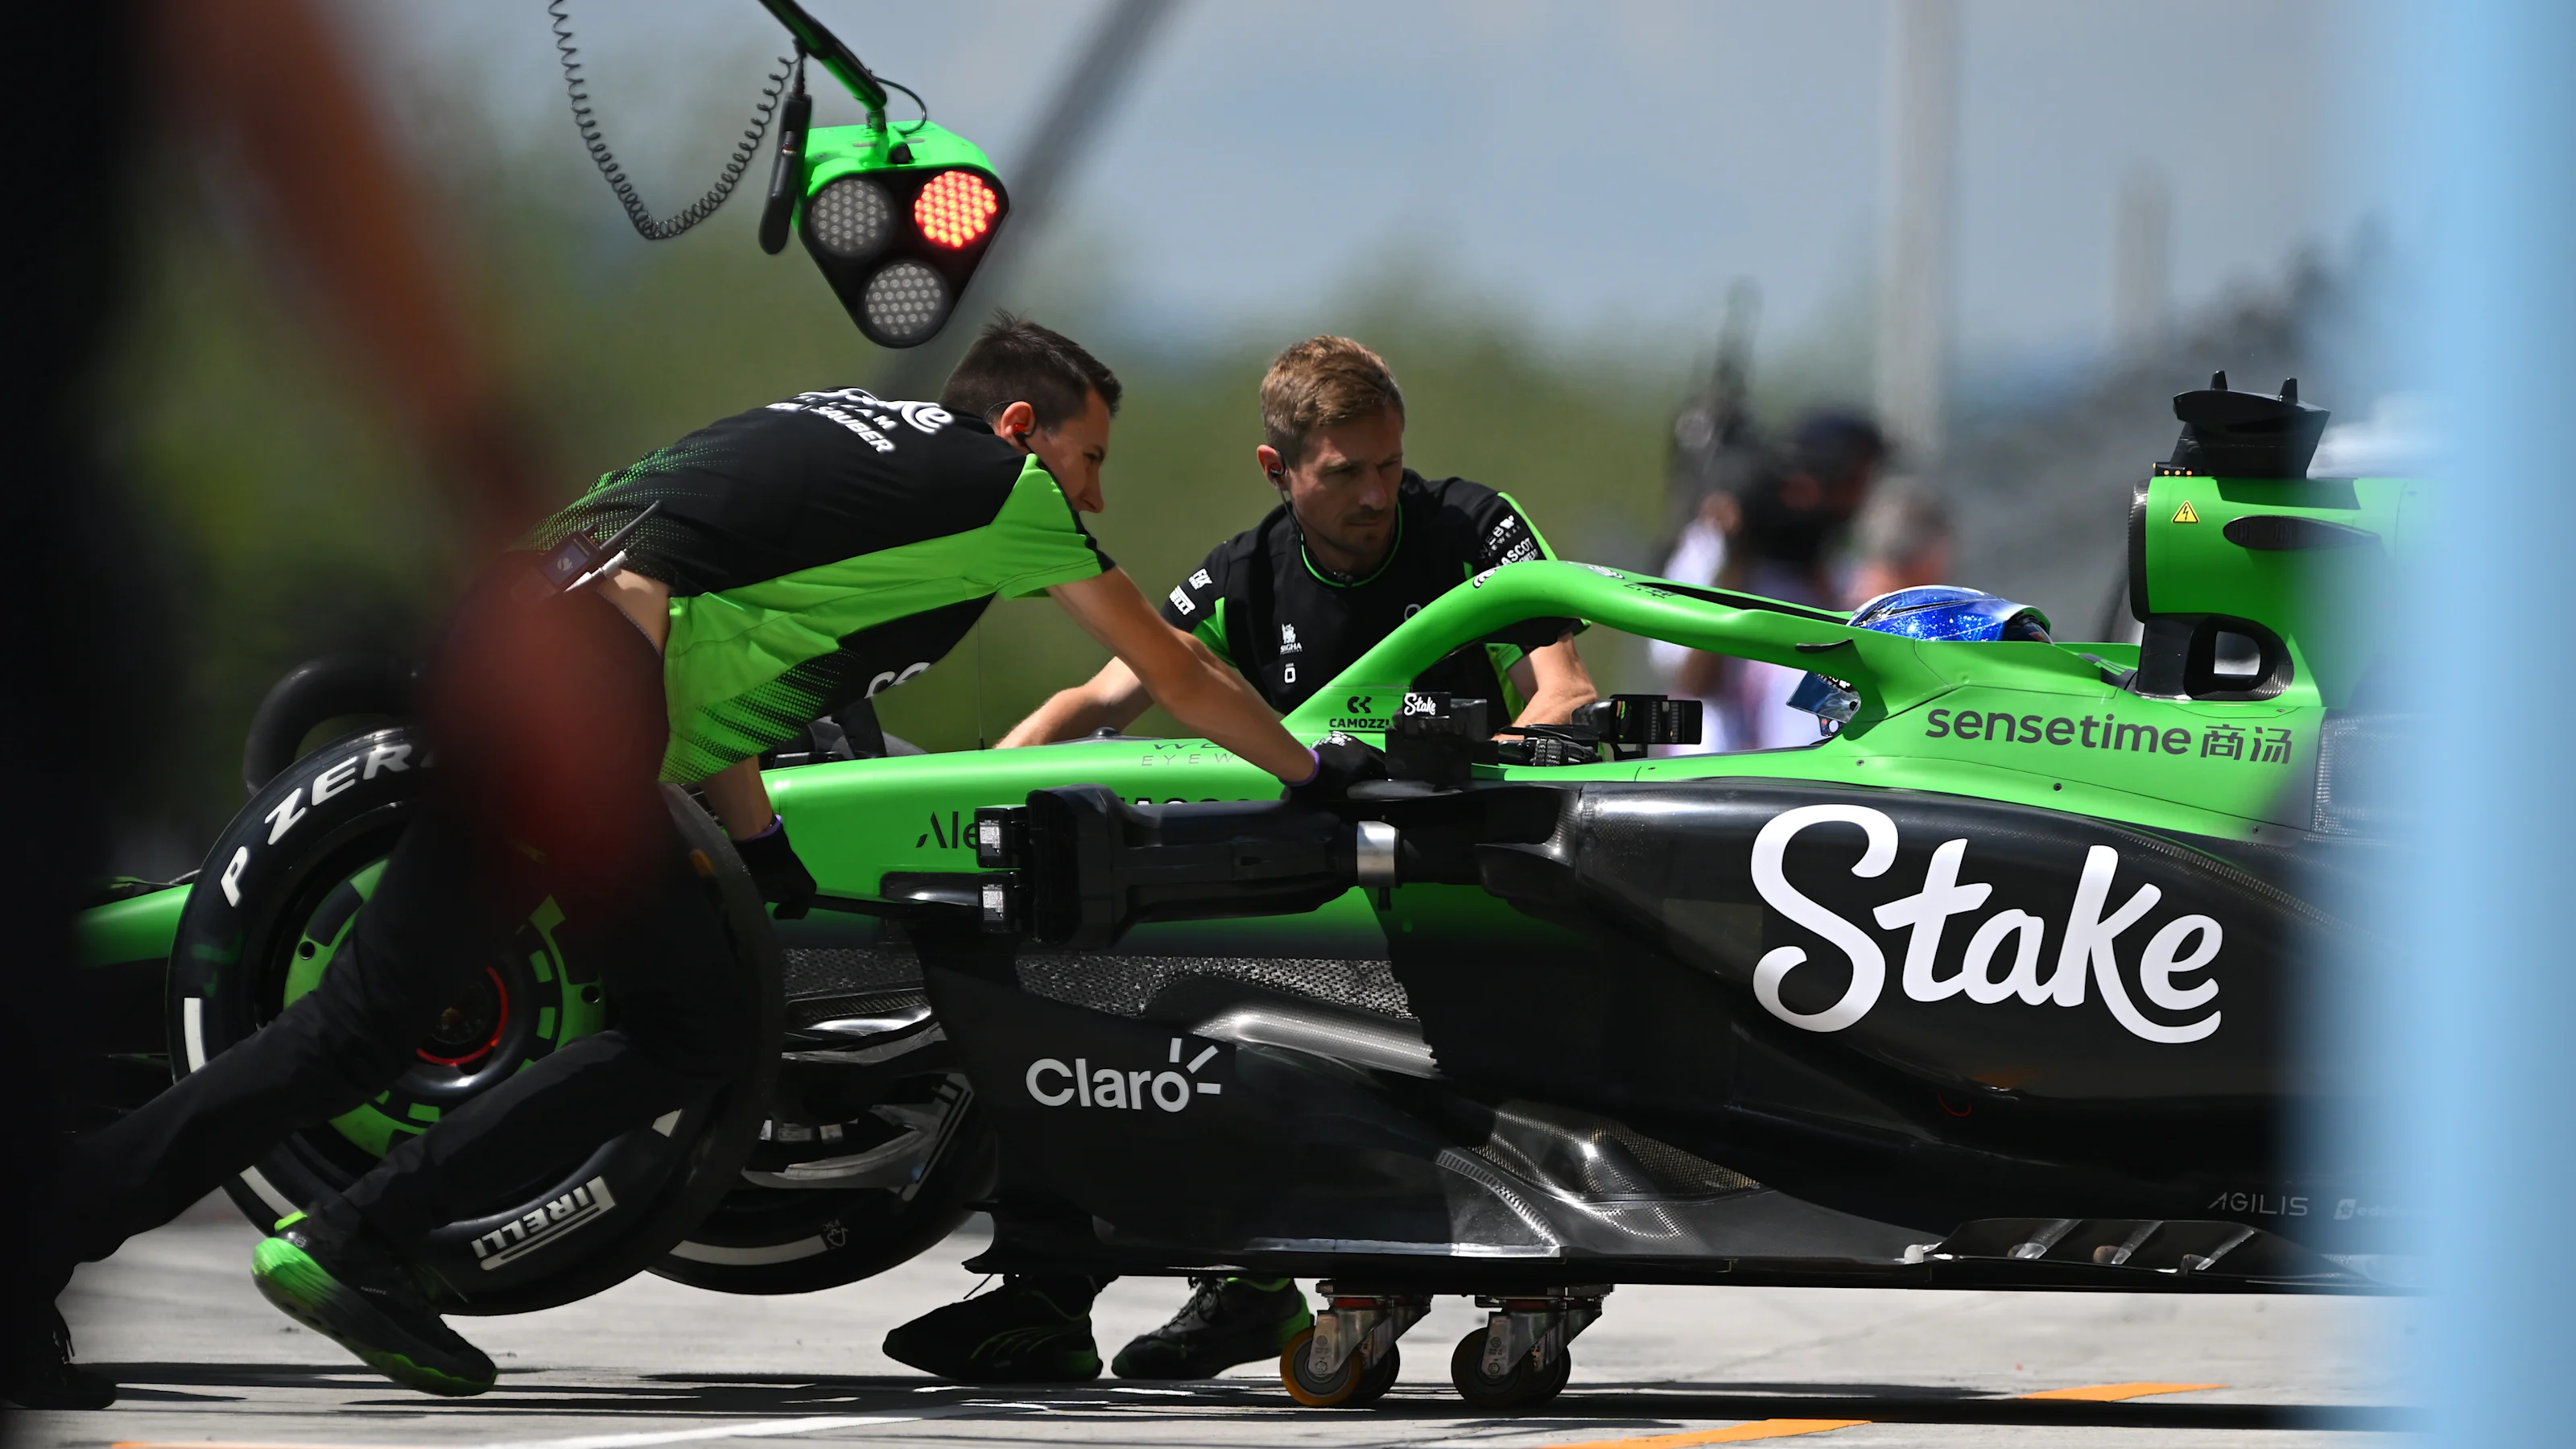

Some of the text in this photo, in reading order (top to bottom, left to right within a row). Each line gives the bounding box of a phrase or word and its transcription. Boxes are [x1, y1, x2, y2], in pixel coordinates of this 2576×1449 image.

[810, 406, 896, 452] SAUBER
[1495, 537, 1534, 567] ASCOT
[1404, 692, 1437, 716] Stake
[1924, 706, 2293, 765] sensetime 商汤
[220, 846, 248, 908] P
[1750, 803, 2223, 1044] Stake
[1026, 1058, 1190, 1113] Claro
[471, 1175, 616, 1271] PIRELLI
[2207, 1191, 2309, 1216] AGILIS
